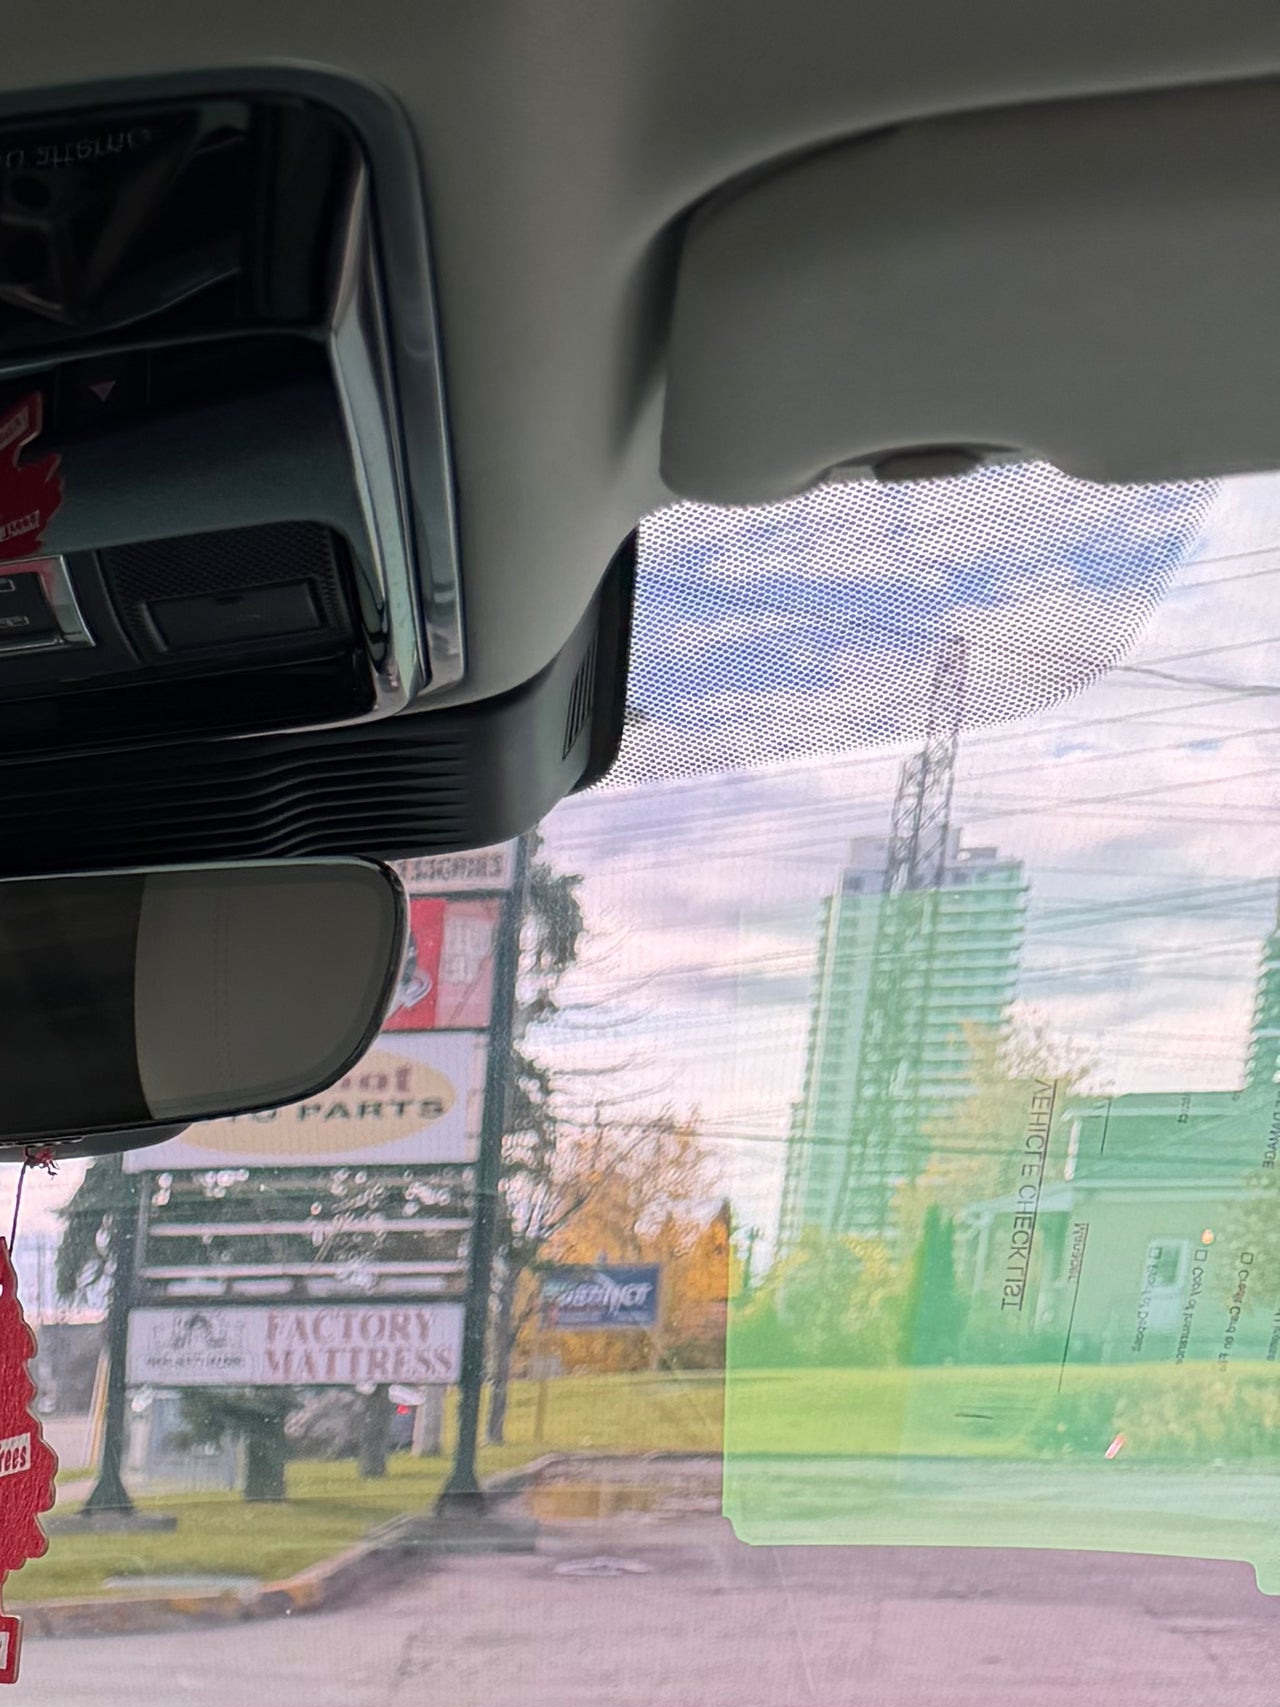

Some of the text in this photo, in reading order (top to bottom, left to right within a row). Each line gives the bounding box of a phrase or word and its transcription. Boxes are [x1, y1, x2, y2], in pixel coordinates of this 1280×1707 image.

[297, 1097, 444, 1121] PARTS
[266, 1310, 435, 1345] FACTORY
[266, 1345, 454, 1380] MATTRESS
